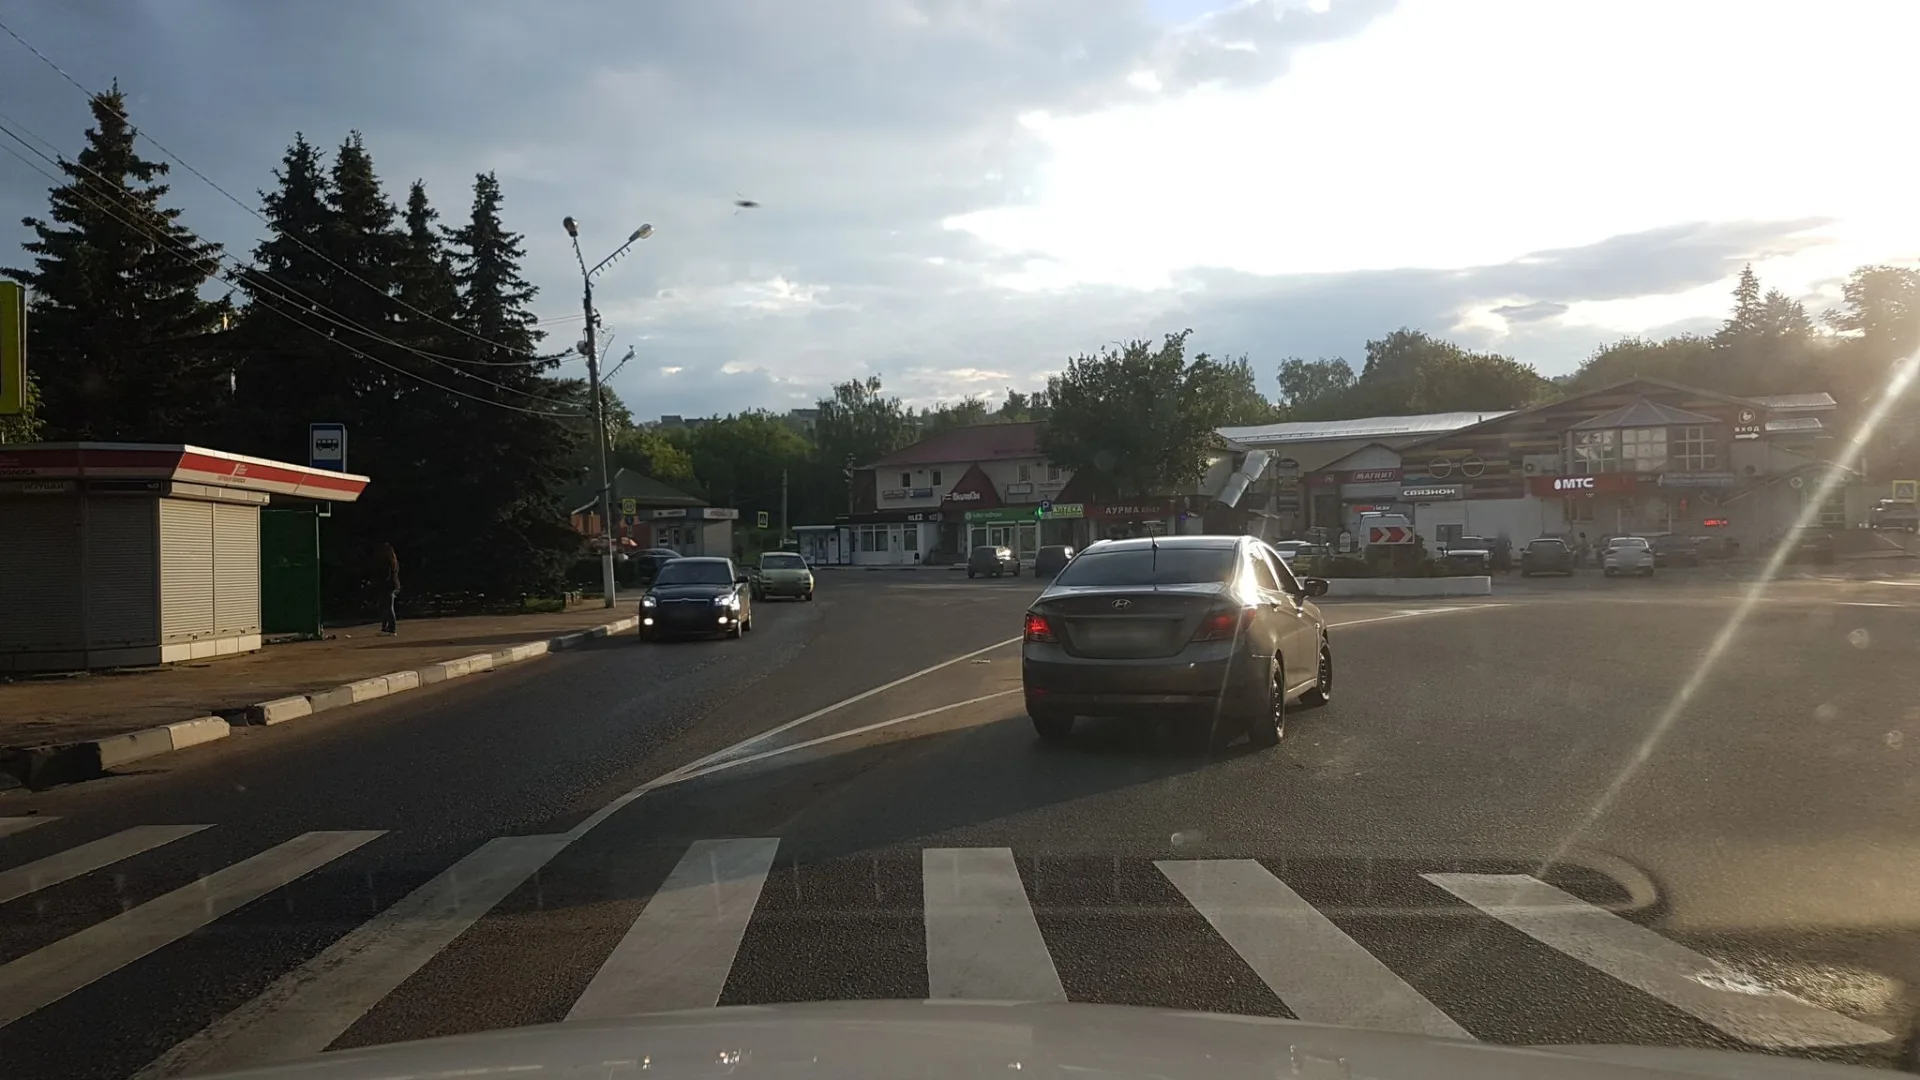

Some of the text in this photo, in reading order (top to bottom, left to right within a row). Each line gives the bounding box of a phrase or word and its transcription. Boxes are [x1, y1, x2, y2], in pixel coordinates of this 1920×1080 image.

[1356, 471, 1393, 481] МАГНИТ
[1562, 477, 1594, 489] МТС
[1051, 504, 1082, 514] АПТЕКА
